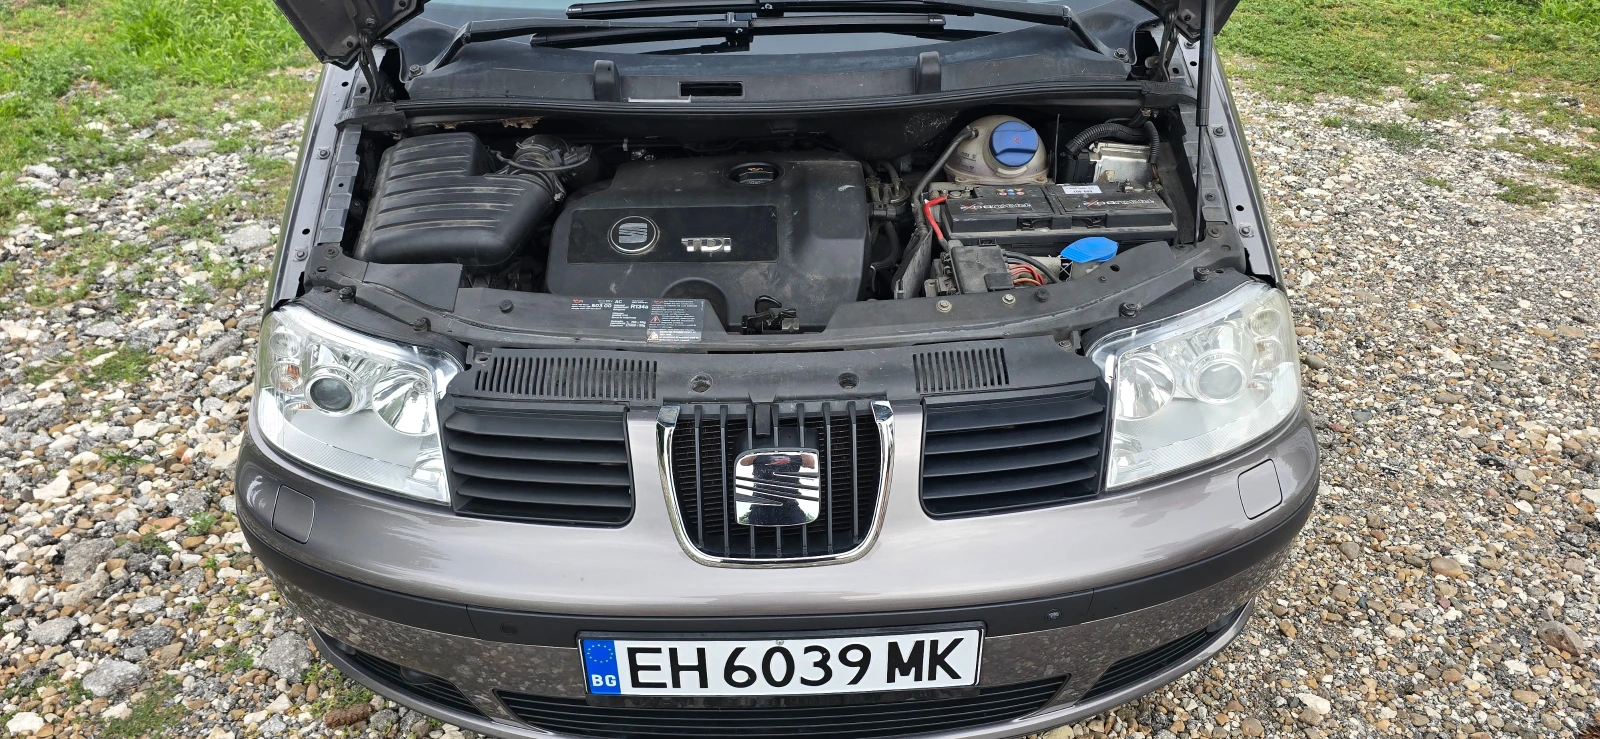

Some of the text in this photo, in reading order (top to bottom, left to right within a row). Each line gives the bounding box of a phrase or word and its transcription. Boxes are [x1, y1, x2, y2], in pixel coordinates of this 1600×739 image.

[681, 237, 732, 252] TDI
[626, 637, 965, 689] EH 6039 MK
[591, 674, 617, 687] BG
